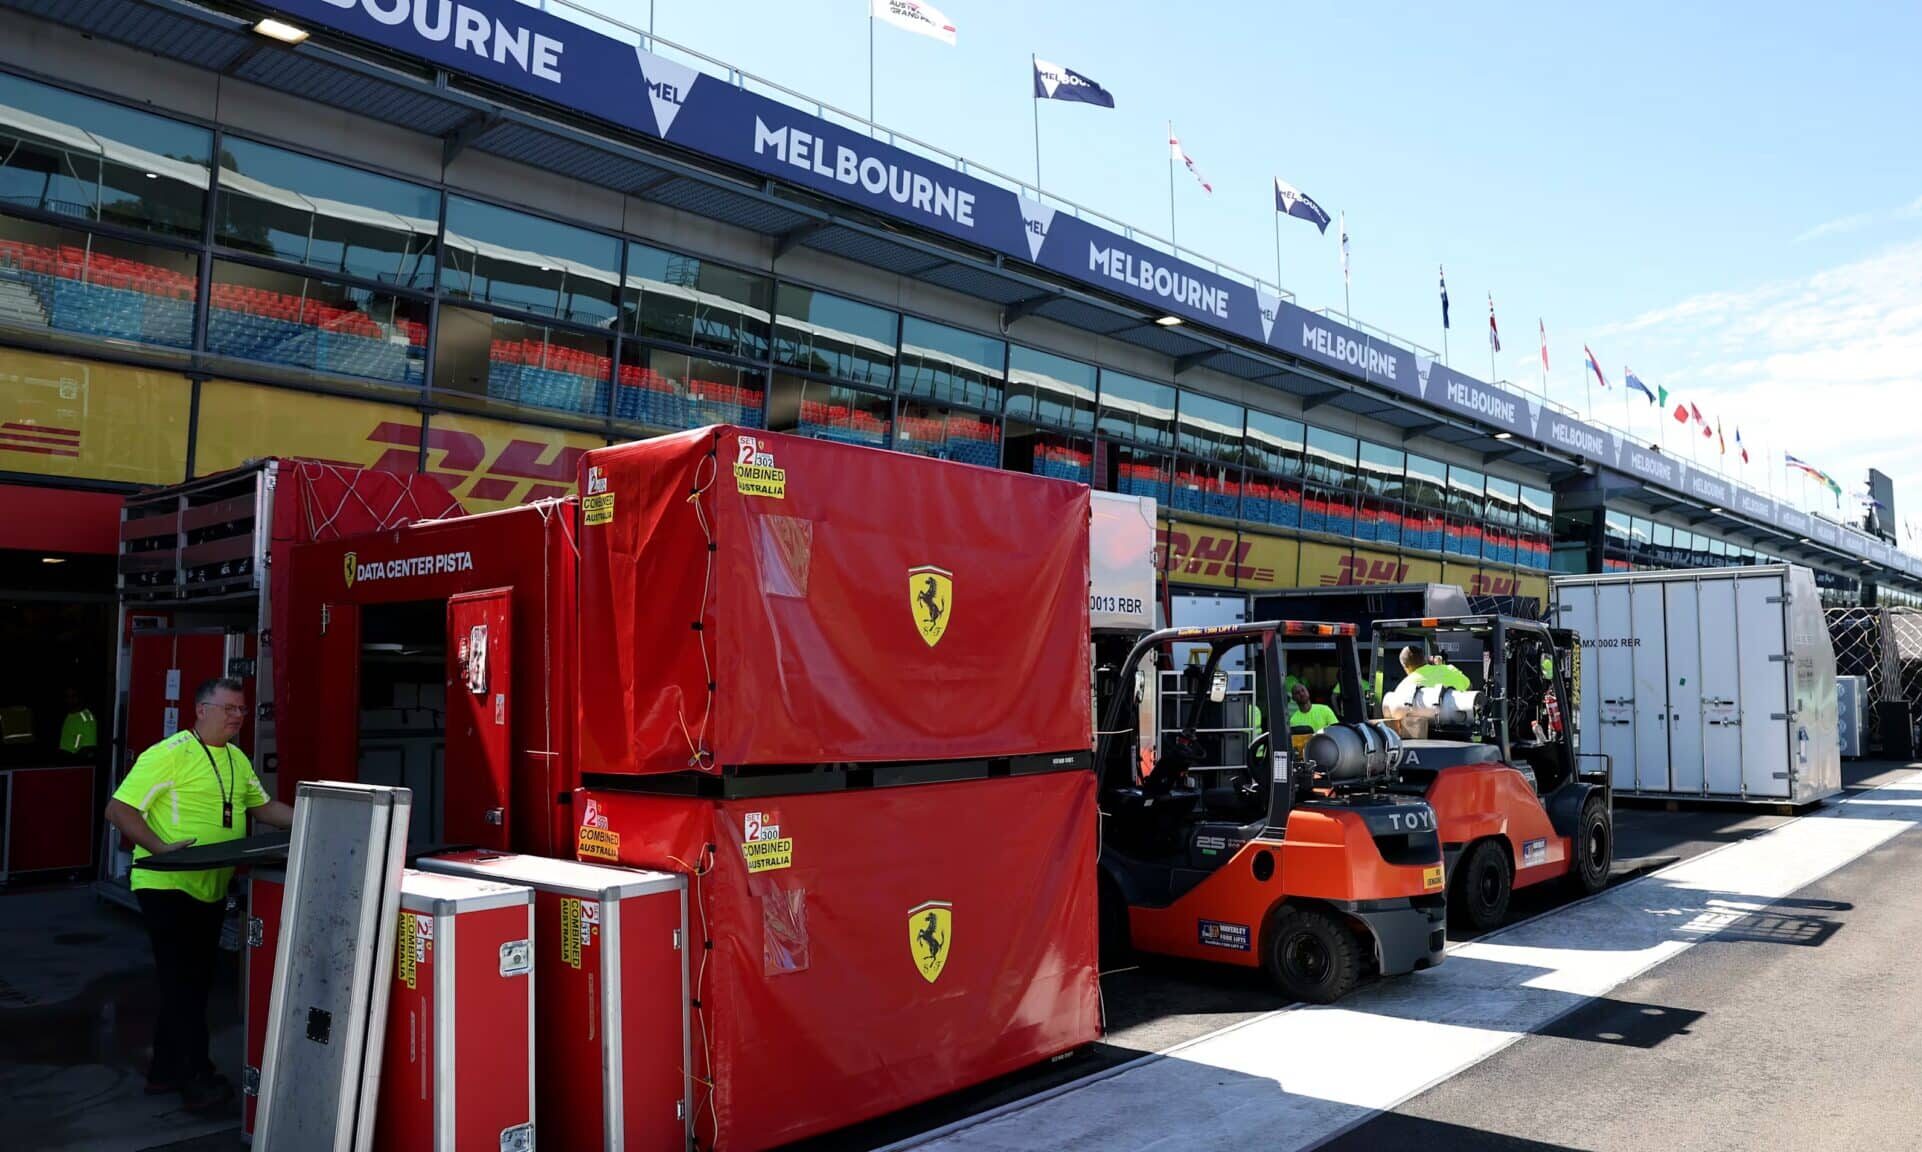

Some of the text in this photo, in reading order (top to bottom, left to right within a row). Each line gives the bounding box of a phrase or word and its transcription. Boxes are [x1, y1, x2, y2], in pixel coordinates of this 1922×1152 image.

[322, 0, 564, 84] OURNE
[645, 77, 682, 106] MEL
[754, 114, 976, 228] MELBOURNE
[1023, 216, 1049, 236] MEL
[1089, 240, 1229, 319] MELBOURNE
[1303, 322, 1397, 380] MELBOURNE
[1447, 379, 1516, 424] MELBOURNE
[1552, 421, 1603, 456] MELBOURNE
[742, 446, 755, 465] 2
[1631, 452, 1672, 482] MELBOURNE
[357, 551, 473, 581] DATA CENTER PISTA
[1118, 597, 1142, 614] RBR
[586, 808, 597, 826] 2
[749, 821, 760, 840] 2
[580, 828, 619, 846] COMBINED
[1196, 836, 1226, 850] 25
[582, 905, 594, 920] 2
[417, 919, 429, 936] 2
[571, 900, 580, 967] COMBINED
